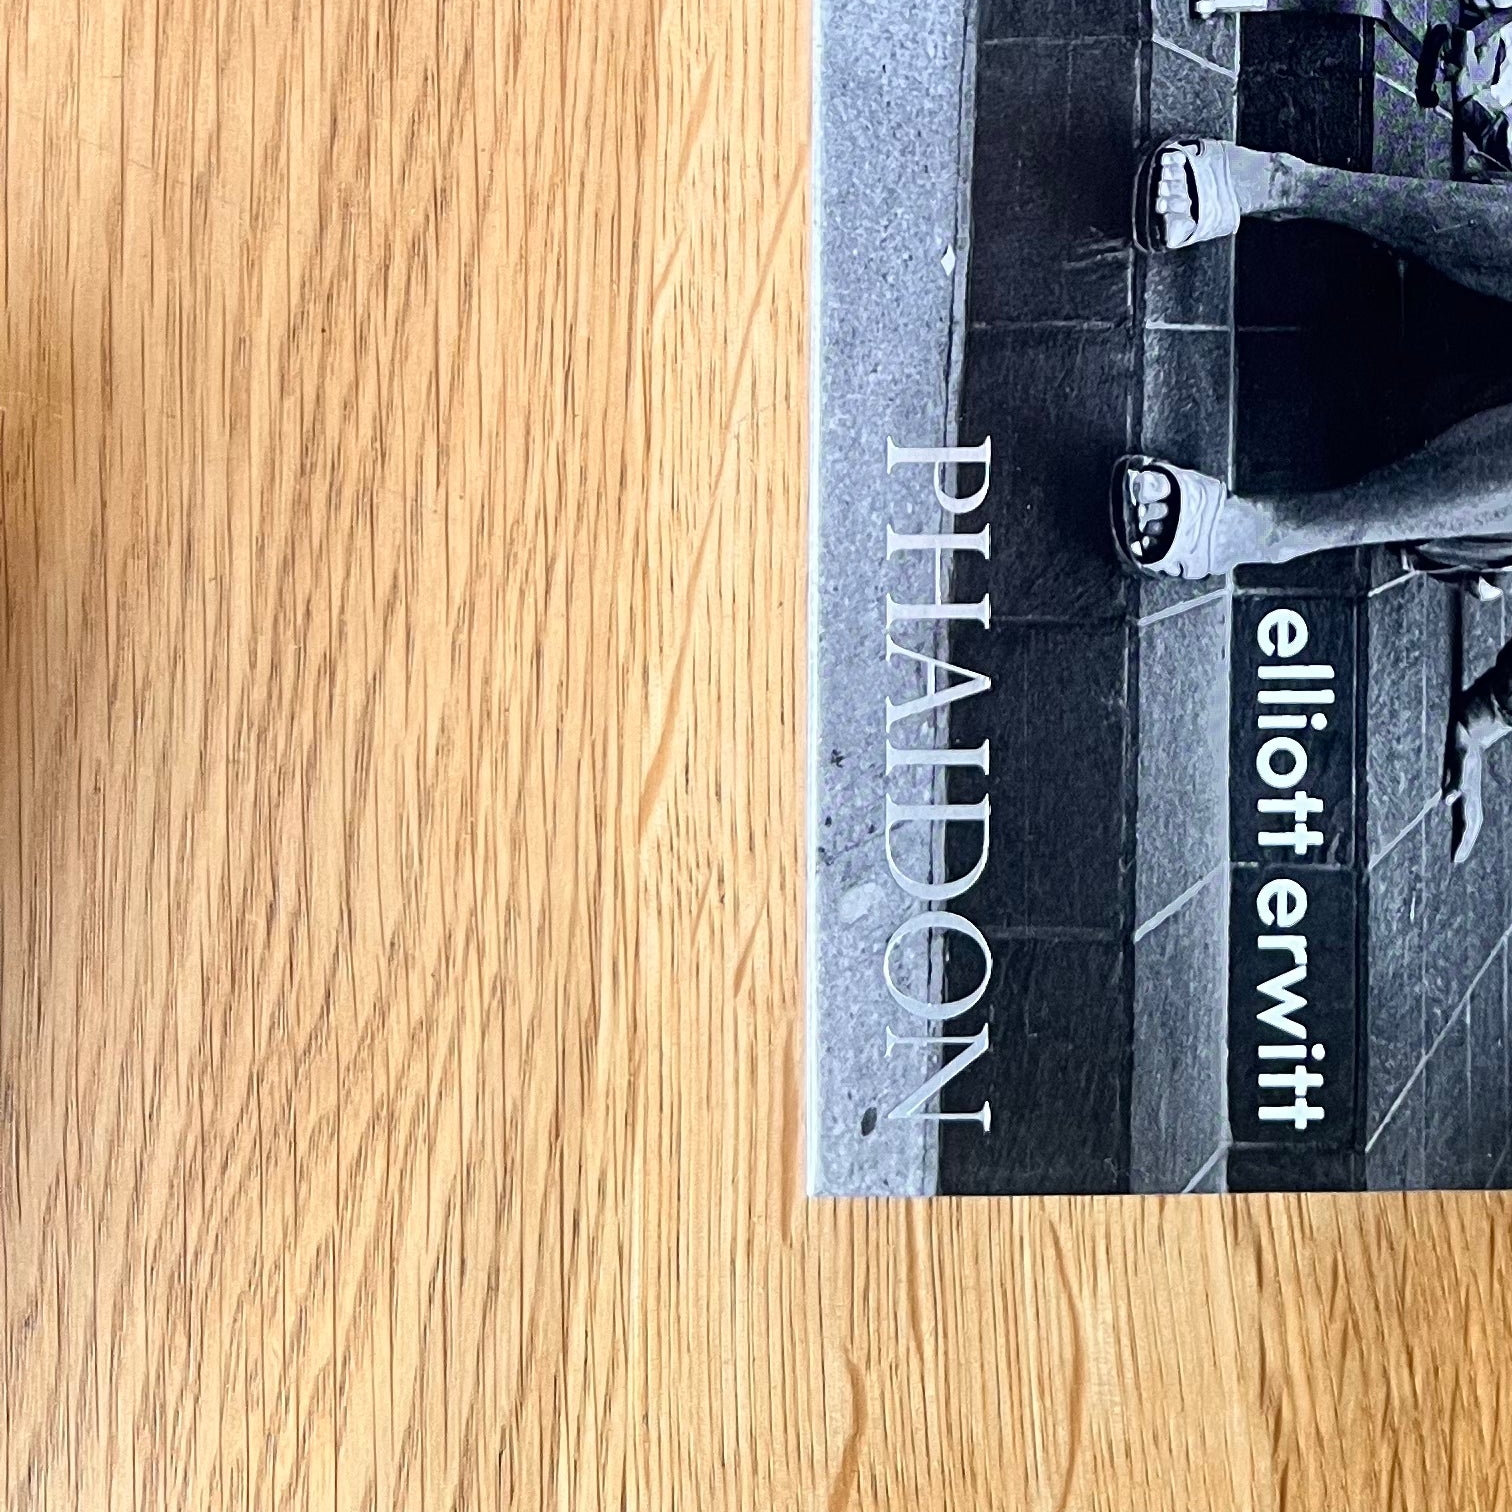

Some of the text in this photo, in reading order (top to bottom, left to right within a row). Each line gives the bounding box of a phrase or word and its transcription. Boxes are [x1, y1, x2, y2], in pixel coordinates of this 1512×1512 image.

[883, 434, 992, 1133] PHAIDON
[1256, 608, 1335, 1130] elliott erwitt
